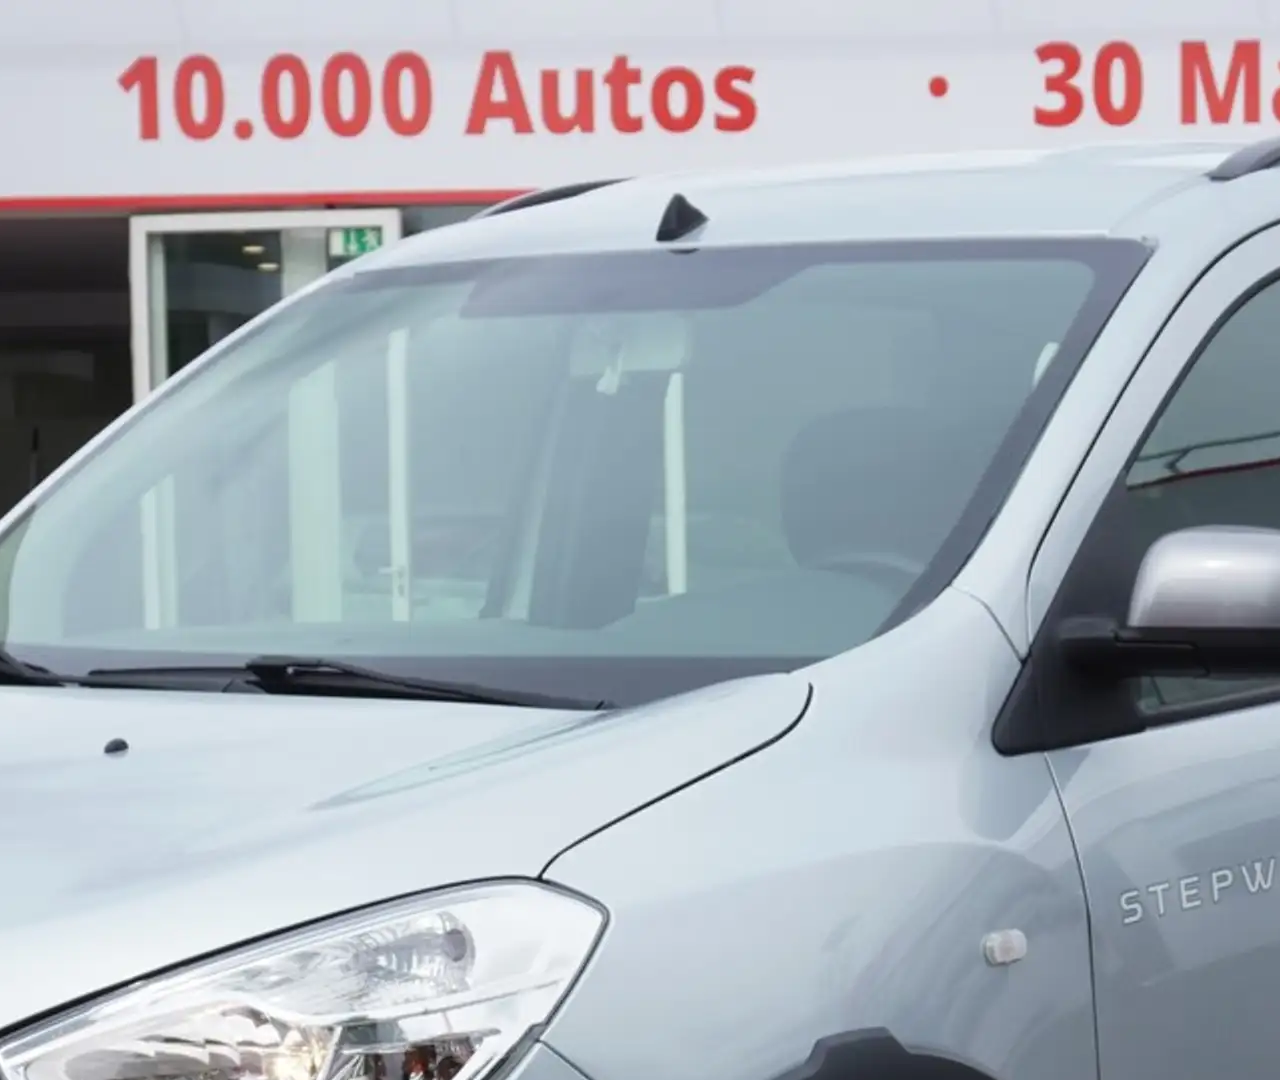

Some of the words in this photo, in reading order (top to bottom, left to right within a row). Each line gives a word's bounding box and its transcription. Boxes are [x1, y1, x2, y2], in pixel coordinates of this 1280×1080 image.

[117, 51, 433, 141] 10.000
[464, 50, 758, 135] Autos
[1033, 39, 1144, 127] 30
